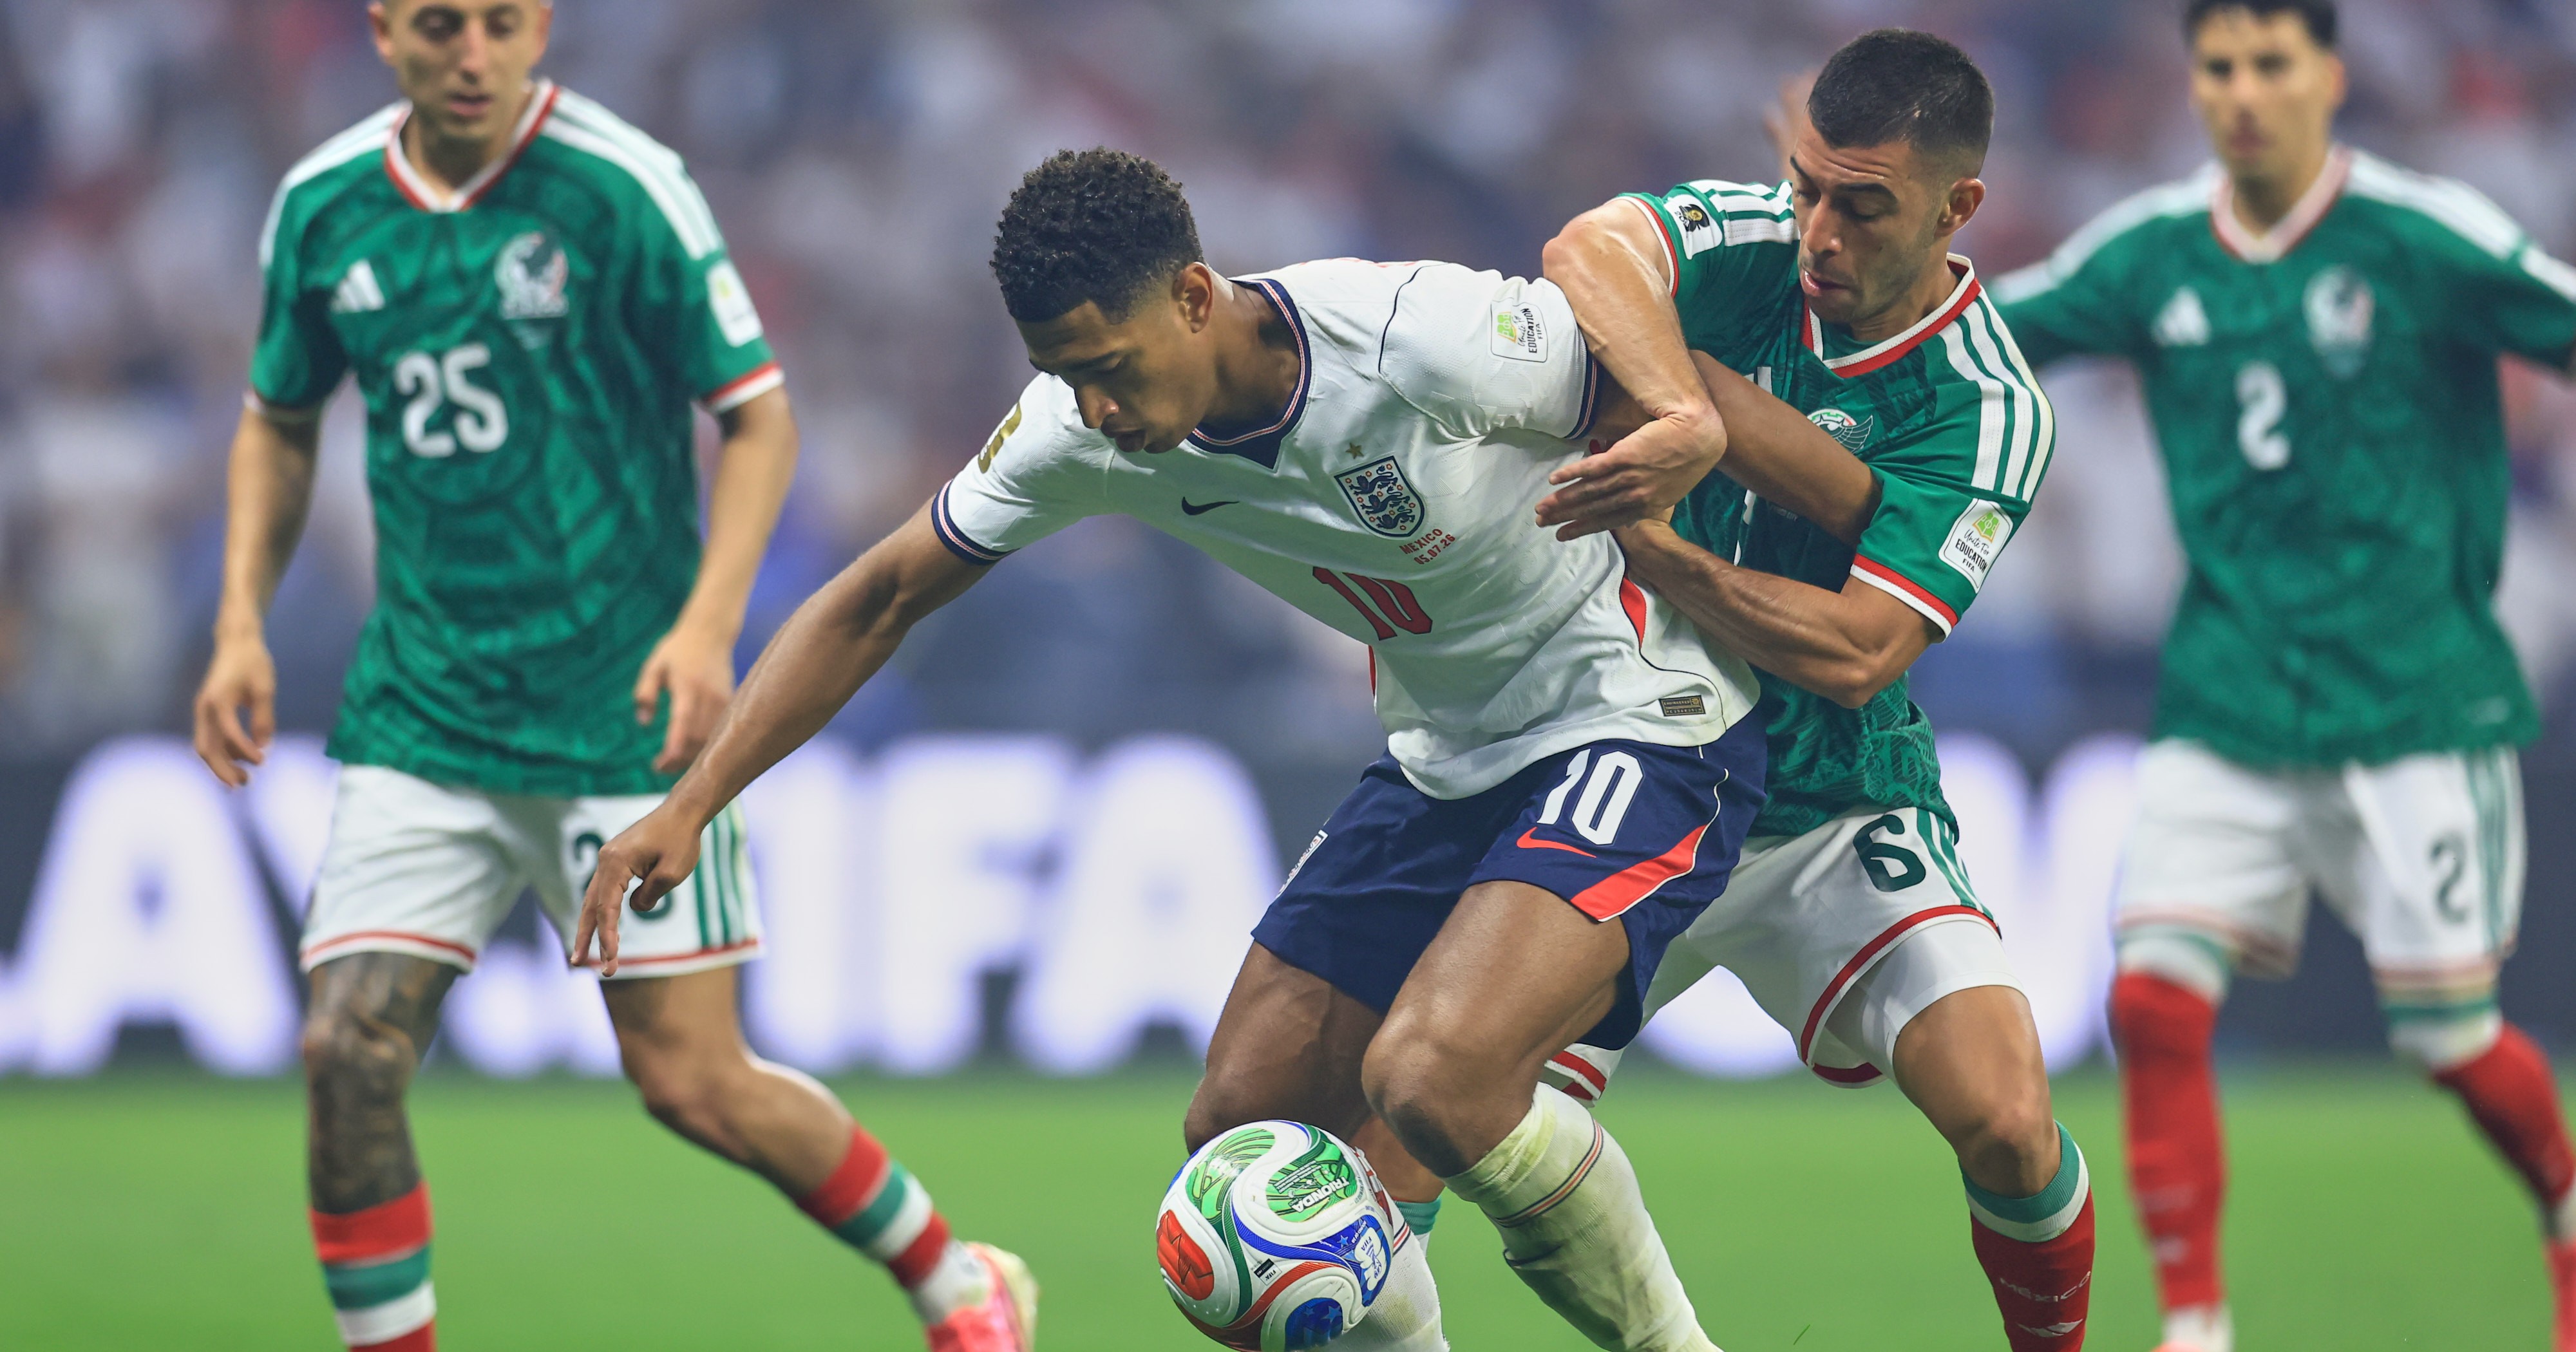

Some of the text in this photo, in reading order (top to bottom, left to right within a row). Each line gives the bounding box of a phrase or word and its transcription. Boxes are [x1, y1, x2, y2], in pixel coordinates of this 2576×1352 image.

[1518, 324, 1526, 346] Unite
[1521, 307, 1538, 353] EDUCATION
[393, 343, 509, 458] 25
[2234, 359, 2291, 471] 2
[1398, 528, 1444, 555] MEXICO
[1413, 534, 1456, 565] 05.07.26
[1955, 538, 1987, 573] EDUCATION
[1964, 529, 1989, 556] Unite For
[1962, 558, 1975, 572] FIFA
[1312, 566, 1434, 641] 10
[1535, 747, 1645, 846] 10
[1853, 813, 1927, 893] 6
[2427, 833, 2470, 925] 2
[1291, 1176, 1350, 1212] TRIONDA
[1360, 1236, 1373, 1251] FIFA
[1265, 1270, 1276, 1280] FIFA
[2000, 1270, 2092, 1302] MEXICO
